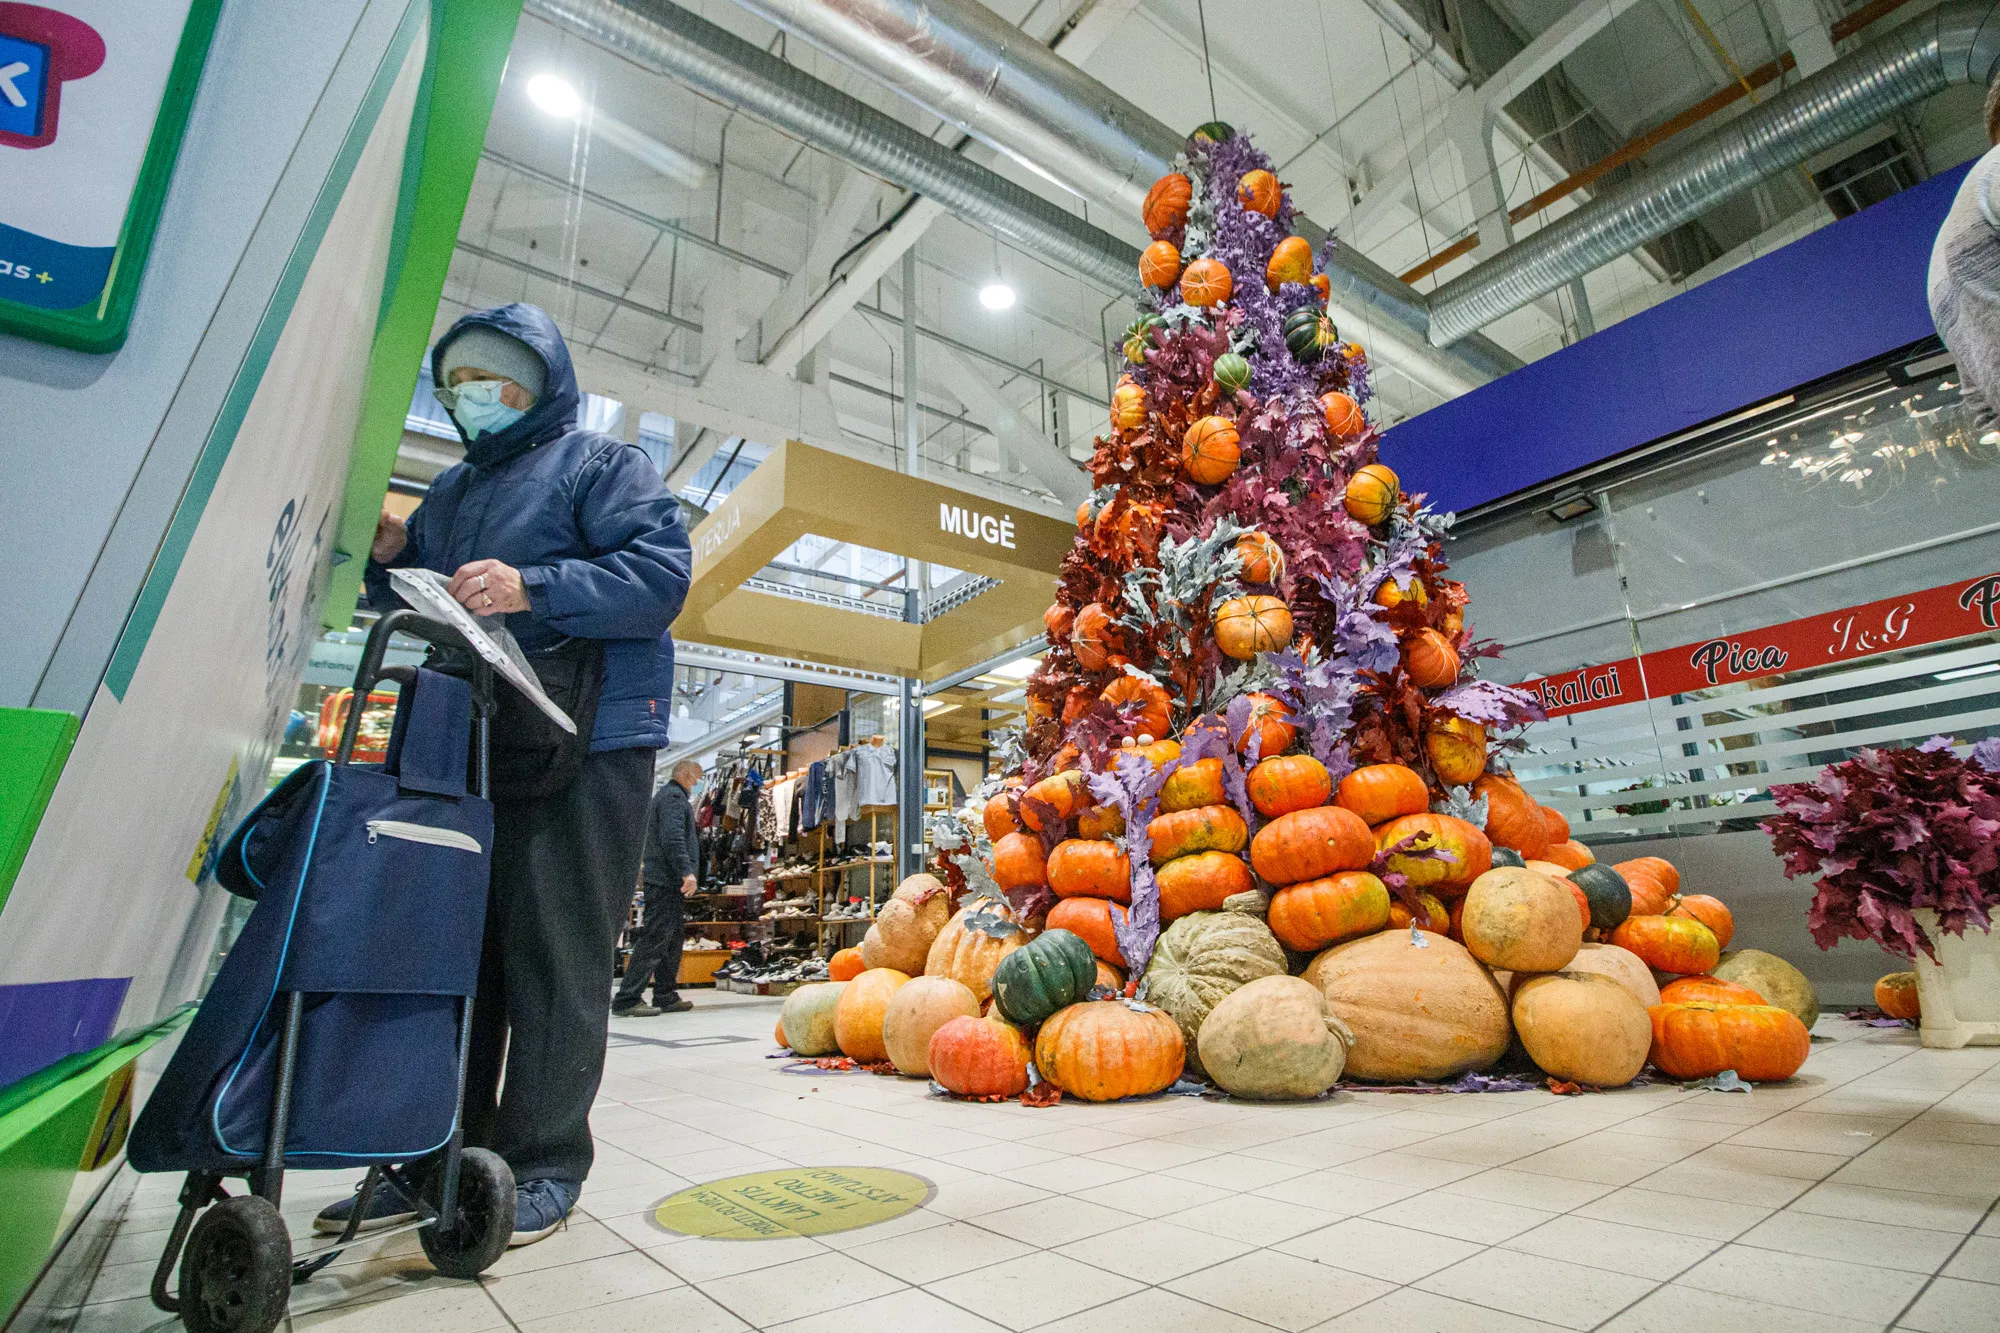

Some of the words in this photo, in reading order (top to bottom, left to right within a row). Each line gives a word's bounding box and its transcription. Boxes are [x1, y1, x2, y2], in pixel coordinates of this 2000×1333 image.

[940, 503, 1017, 550] MUGĖ
[1690, 640, 1788, 685] Pica
[733, 1186, 821, 1221] LAIKYTIS
[773, 1179, 846, 1205] METRO
[804, 1170, 909, 1203] ATSTUMO!
